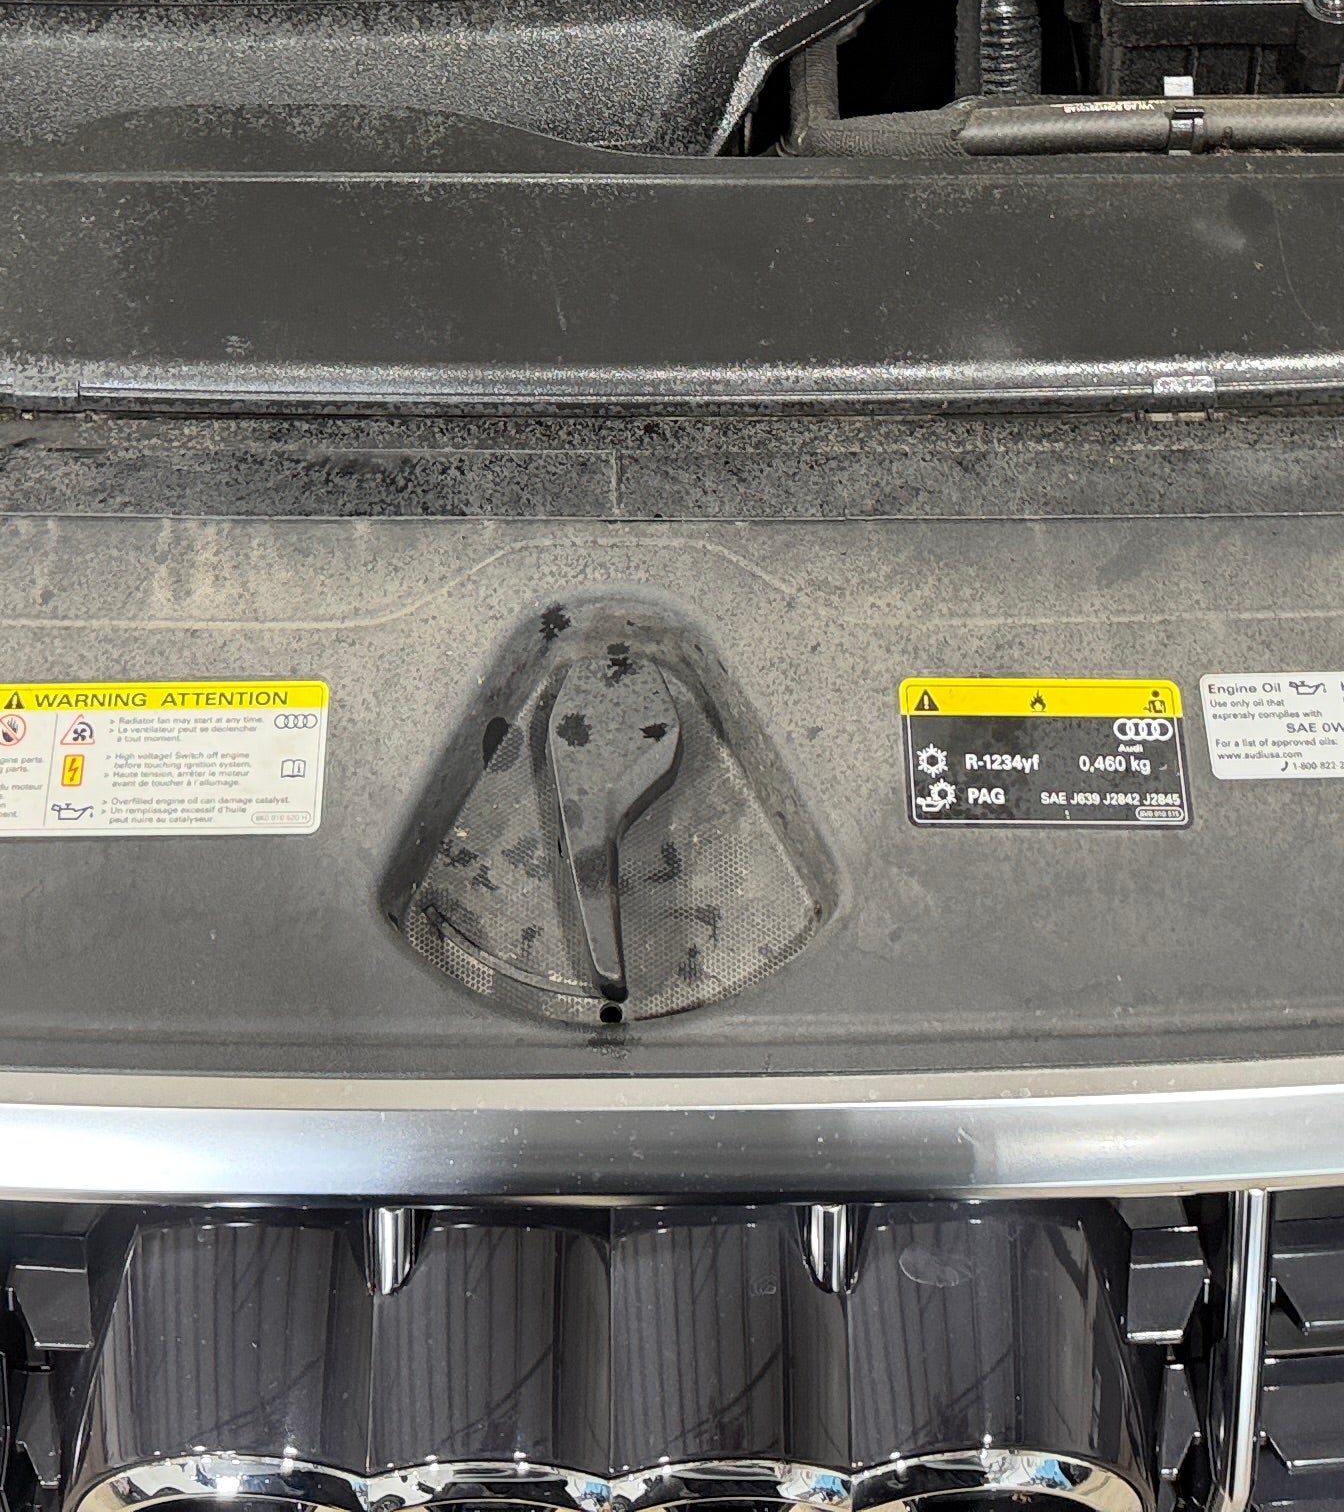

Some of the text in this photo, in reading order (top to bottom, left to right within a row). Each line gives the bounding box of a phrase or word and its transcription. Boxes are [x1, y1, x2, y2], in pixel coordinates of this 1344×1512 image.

[1208, 682, 1282, 696] Engine Oil
[35, 691, 288, 708] WARNING ATTENTION
[1210, 698, 1286, 708] Use only oil that
[1212, 709, 1323, 720] expressly complies with
[173, 718, 190, 726] may
[226, 718, 241, 726] any
[178, 726, 198, 734] peut
[1286, 722, 1318, 733] SAE
[1216, 738, 1232, 748] For
[1242, 738, 1256, 747] list
[1259, 738, 1269, 747] of
[1271, 738, 1316, 748] approved
[1118, 744, 1144, 753] Audi
[115, 752, 135, 761] High
[175, 752, 204, 760] Switch
[207, 751, 218, 760] off
[220, 752, 250, 760] engine
[1216, 750, 1303, 760] www.audiusa.com
[114, 761, 141, 770] before
[144, 761, 182, 770] touching
[184, 760, 216, 770] ignition
[964, 754, 1040, 774] R-1234yf
[1130, 755, 1152, 776] kg
[138, 780, 149, 788] de
[152, 779, 184, 788] toucher
[111, 798, 154, 806] Overfilled
[156, 798, 185, 807] engine
[187, 796, 198, 805] oil
[218, 797, 253, 806] damage
[968, 788, 1180, 806] PAG SAE J639 J2842 J2845
[110, 806, 247, 816] Un remplissage excessif d'huile
[109, 816, 129, 824] peut
